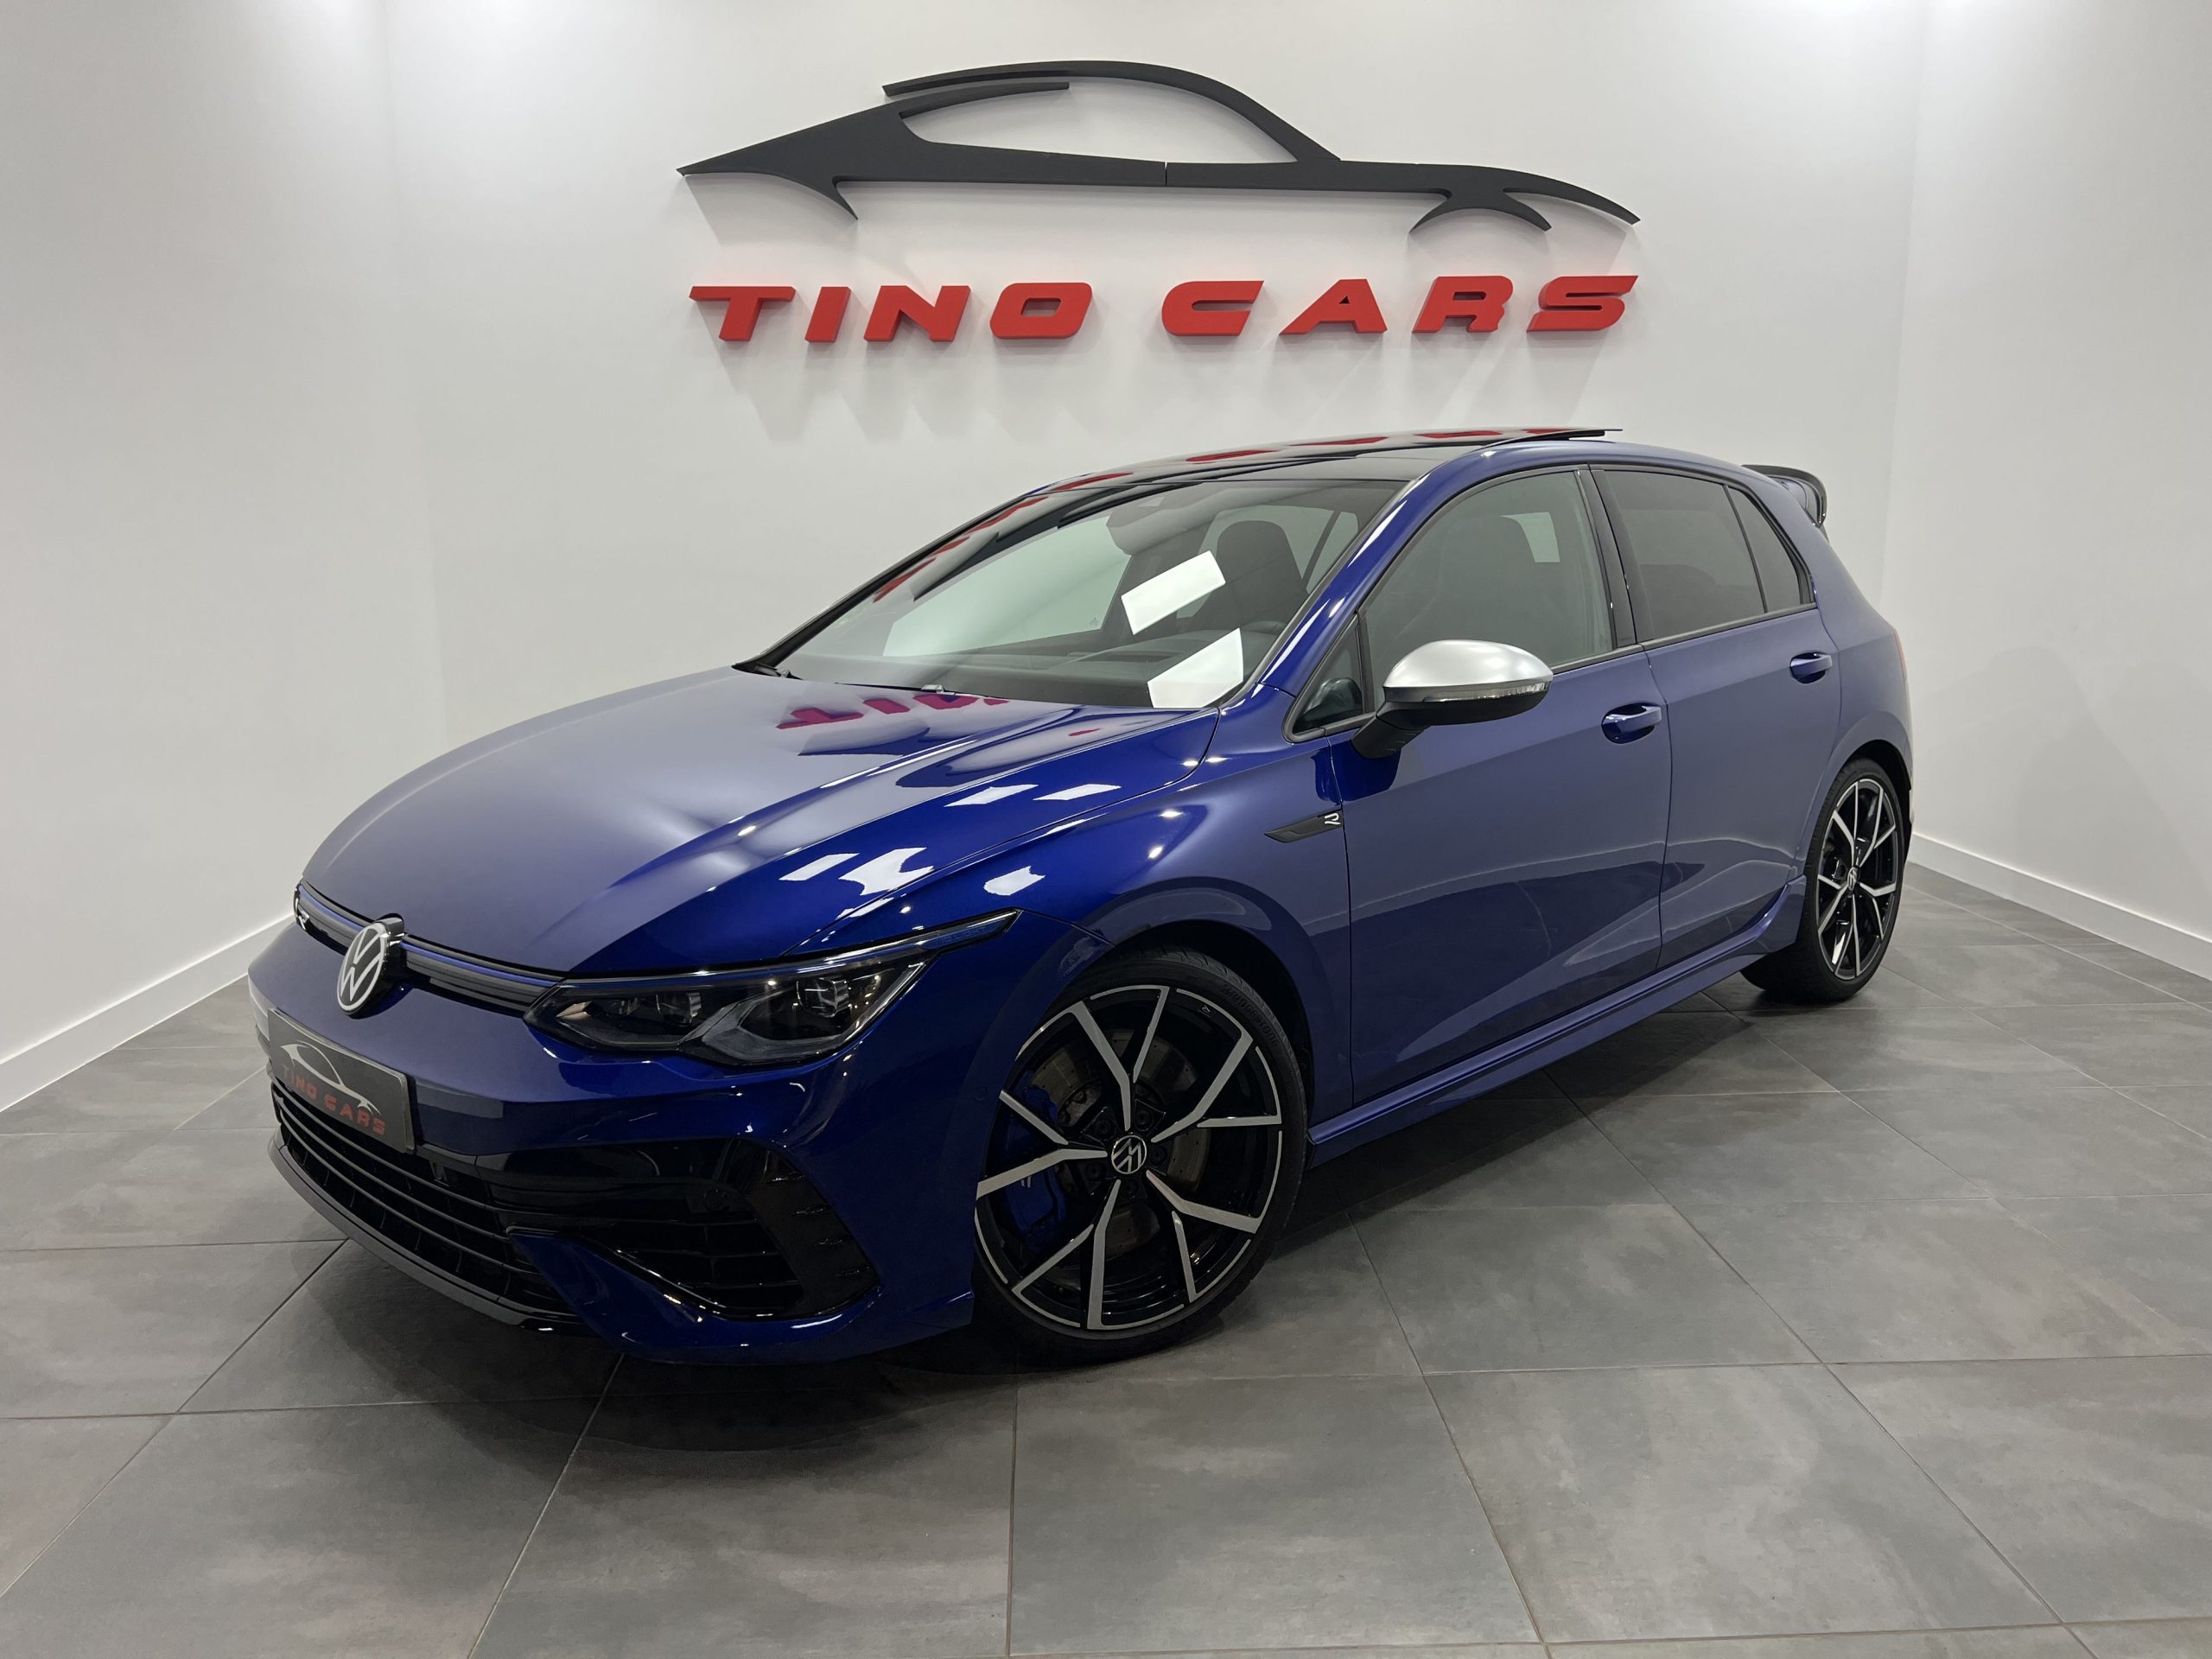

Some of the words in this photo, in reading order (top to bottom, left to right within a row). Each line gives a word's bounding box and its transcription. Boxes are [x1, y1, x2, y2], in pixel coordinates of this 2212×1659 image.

[690, 283, 1092, 342] TINO
[1161, 275, 1638, 336] CARS
[283, 1064, 318, 1100] TINO
[324, 1094, 385, 1135] CARS
